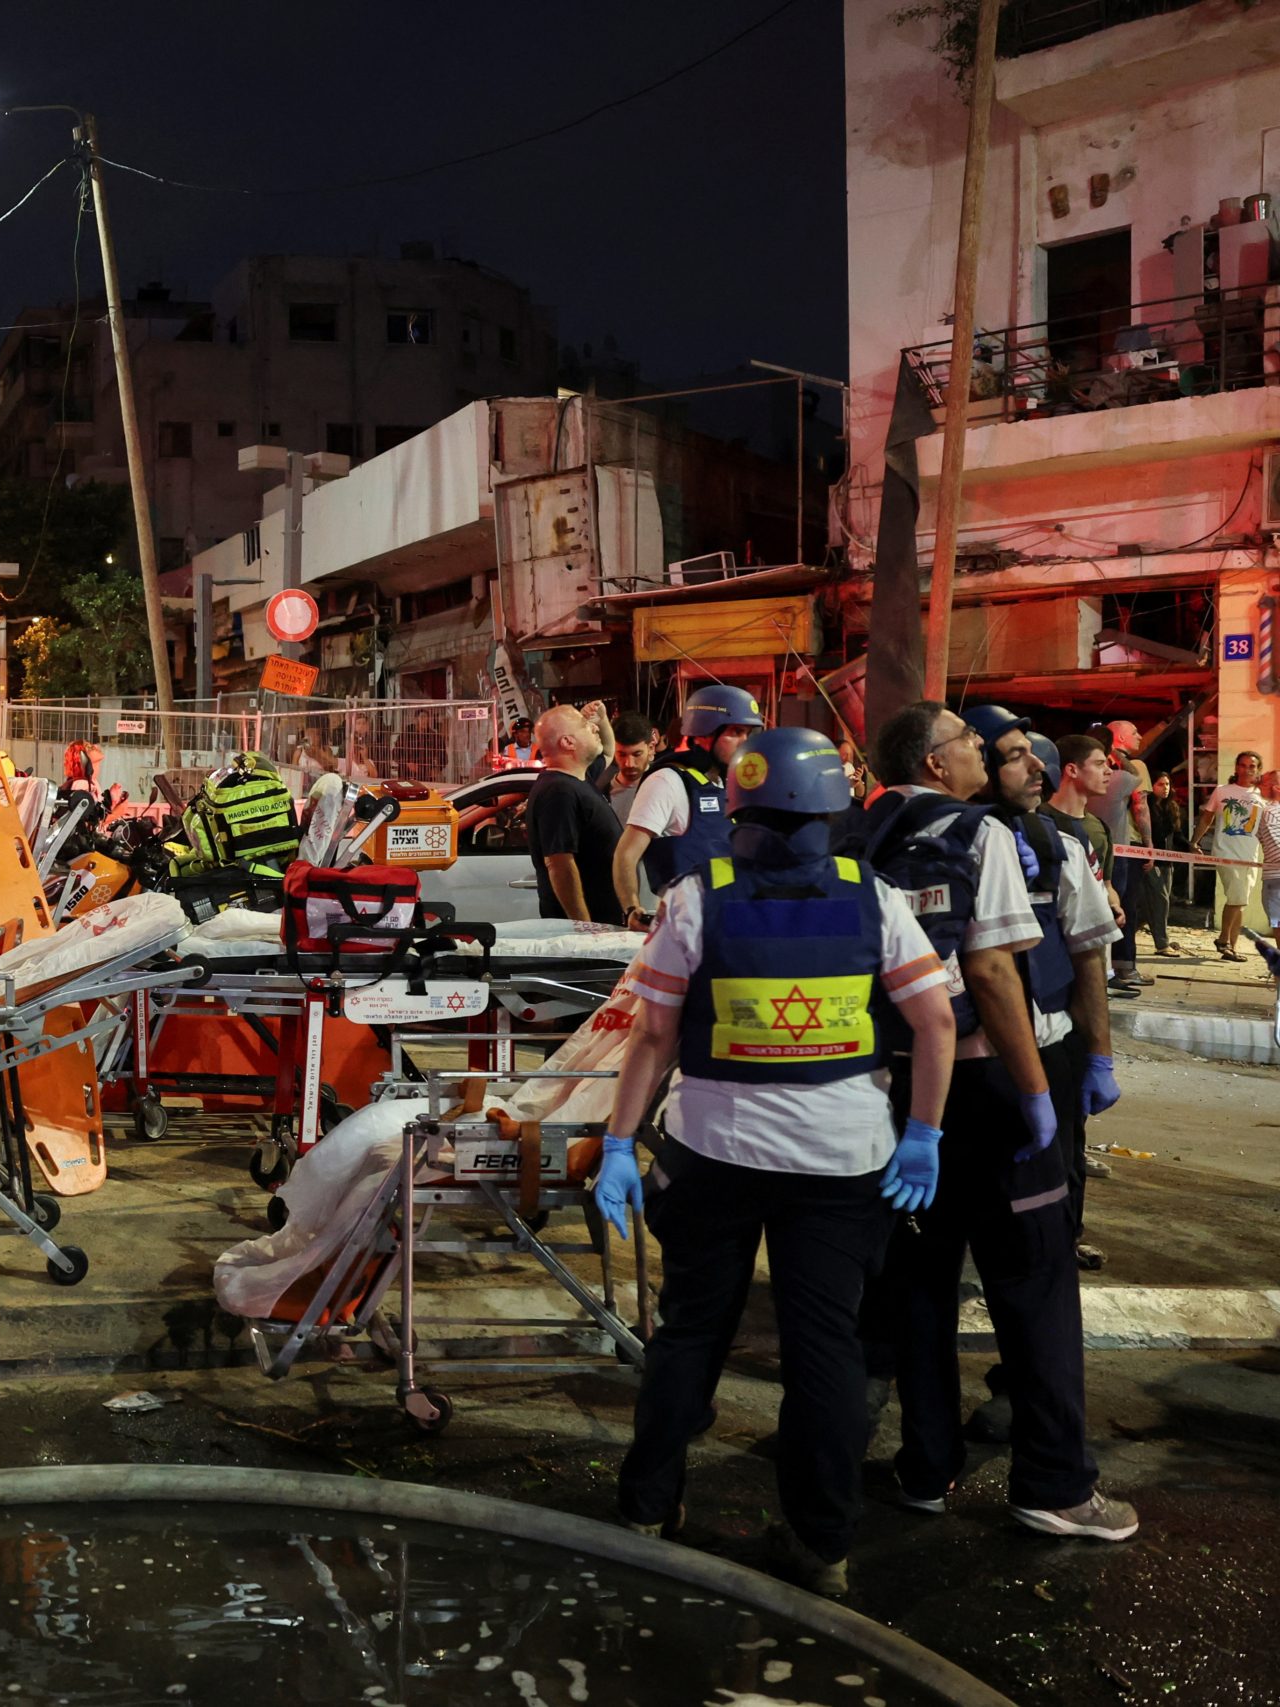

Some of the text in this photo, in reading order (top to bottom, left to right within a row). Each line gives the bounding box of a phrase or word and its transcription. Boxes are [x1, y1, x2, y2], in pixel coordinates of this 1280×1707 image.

[1228, 640, 1249, 655] 38
[228, 809, 249, 820] MAGEN
[270, 801, 288, 810] ADOM
[392, 828, 418, 836] איחוד
[392, 837, 418, 845] הצלה
[64, 885, 89, 912] 1580
[473, 1154, 552, 1168] FERO
